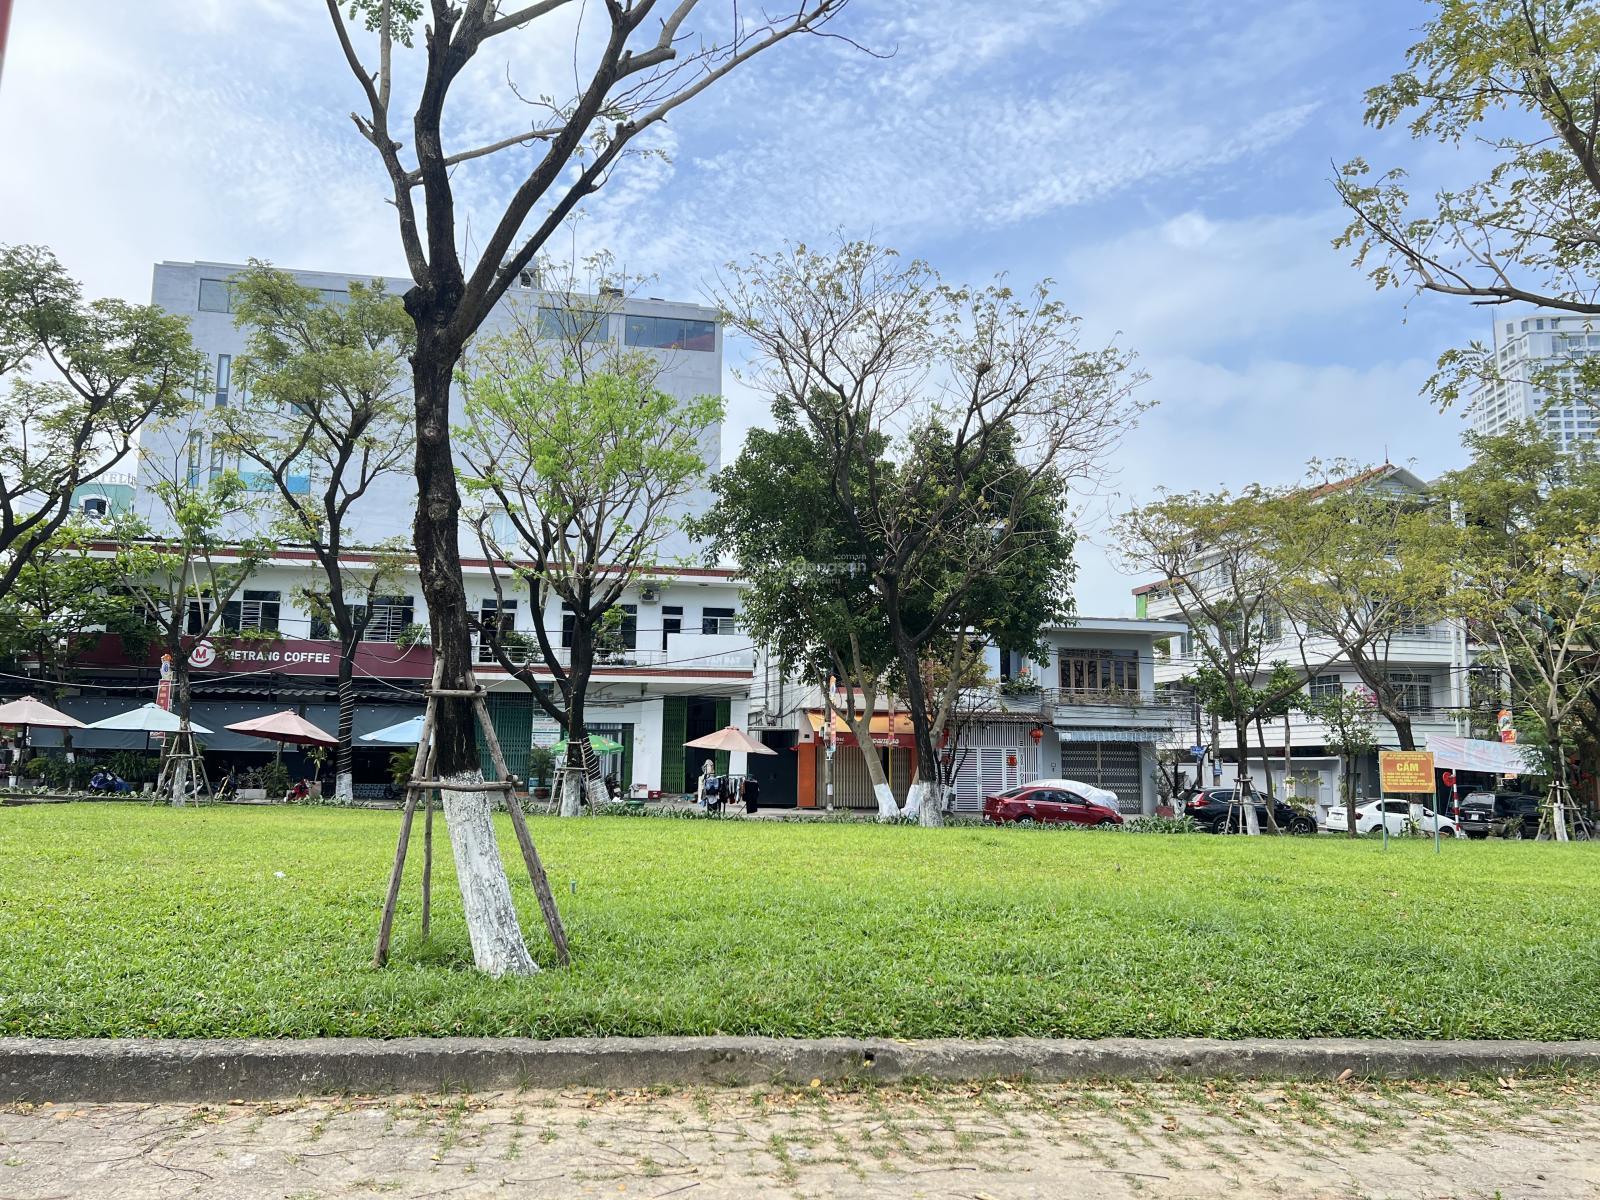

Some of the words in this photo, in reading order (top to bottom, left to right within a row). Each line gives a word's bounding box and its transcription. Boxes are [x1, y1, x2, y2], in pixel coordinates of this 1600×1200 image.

[195, 649, 207, 659] M
[224, 650, 280, 662] METRANG
[284, 652, 331, 663] COFFEE
